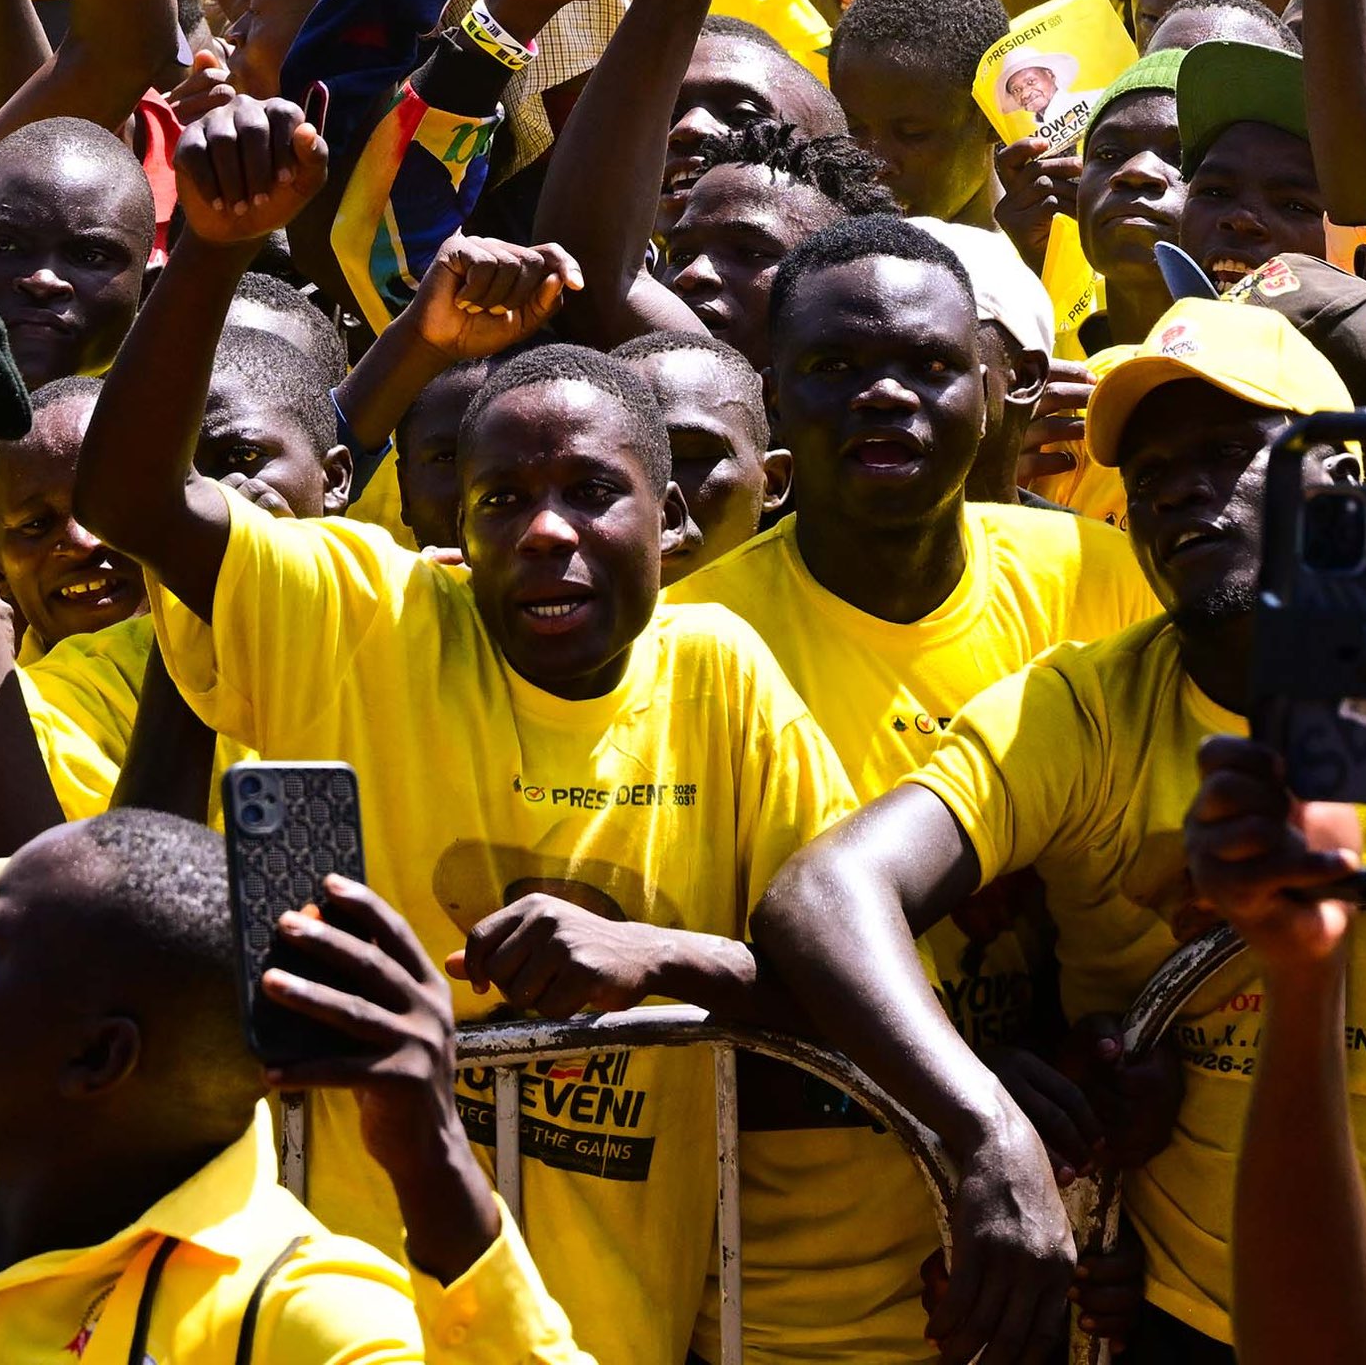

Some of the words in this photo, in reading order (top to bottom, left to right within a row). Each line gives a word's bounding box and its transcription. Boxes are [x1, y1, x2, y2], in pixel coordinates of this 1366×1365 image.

[986, 21, 1049, 67] PRESIDENT
[673, 784, 697, 795] 2026
[533, 1126, 571, 1150] THE
[575, 1139, 633, 1161] GAINS
